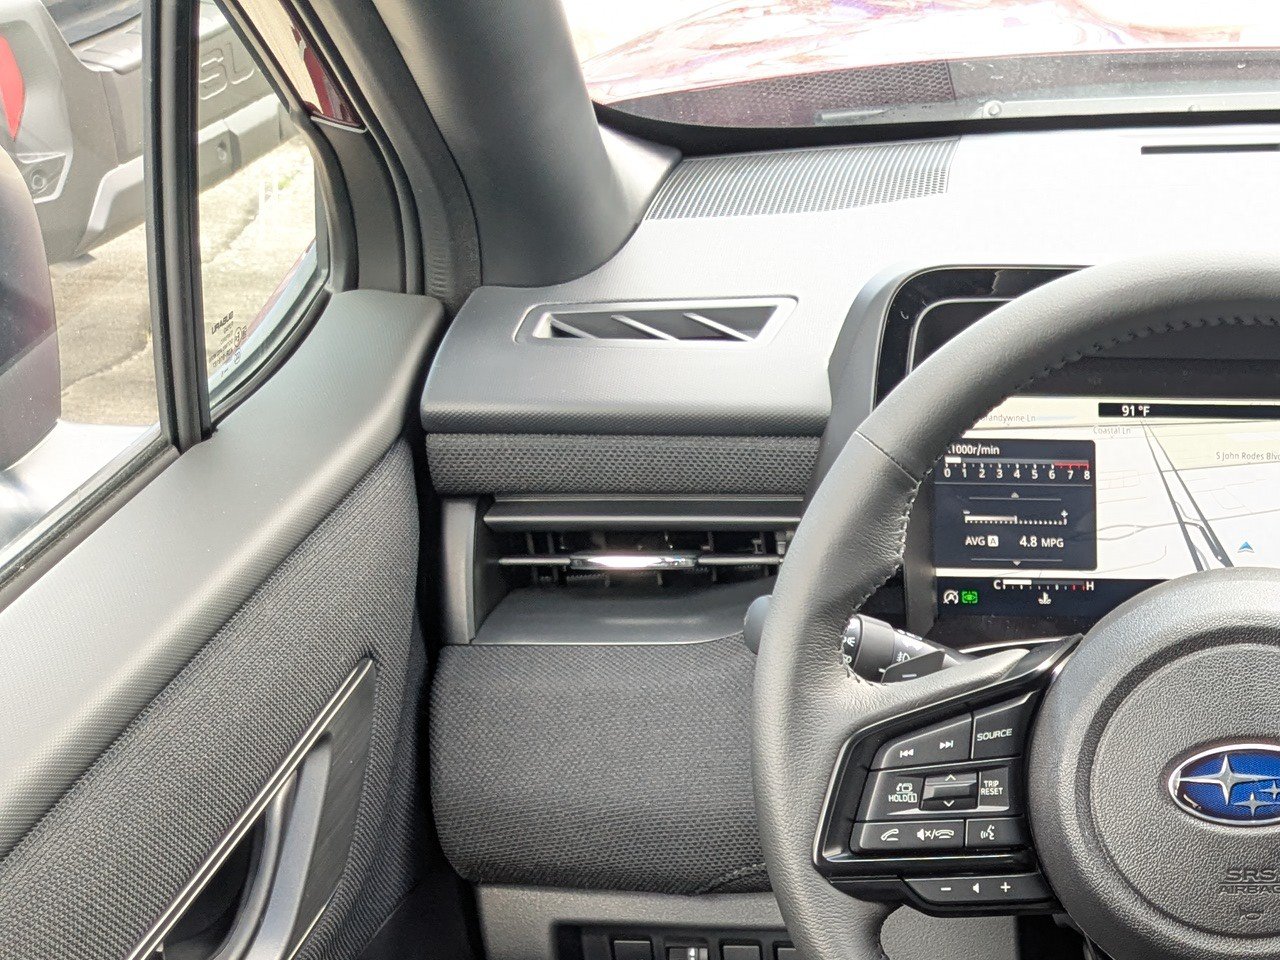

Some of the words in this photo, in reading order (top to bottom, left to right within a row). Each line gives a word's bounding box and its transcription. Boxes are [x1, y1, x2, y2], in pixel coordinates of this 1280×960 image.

[1121, 405, 1135, 417] 91
[1093, 426, 1120, 435] Coastal
[1121, 427, 1131, 435] Ln
[948, 443, 1000, 455] 1000r/min
[1216, 452, 1221, 460] S
[1221, 452, 1240, 461] John
[1242, 452, 1264, 460] Rodes
[944, 468, 951, 478] 0
[961, 468, 967, 478] 1
[978, 469, 986, 479] 2
[996, 469, 1003, 479] 3
[1013, 469, 1021, 479] 4
[1031, 469, 1039, 480] 5
[1049, 470, 1056, 480] 6
[1067, 470, 1074, 480] 7
[1083, 470, 1091, 480] 8
[965, 537, 985, 546] AVG
[1019, 536, 1038, 547] 4.8
[1041, 537, 1064, 547] MPG
[993, 580, 1001, 590] C
[1086, 581, 1094, 590] H
[976, 728, 1013, 741] SOURCE
[983, 780, 999, 789] TRIP
[980, 786, 1003, 796] RESET
[888, 793, 907, 803] HOLD
[1225, 868, 1277, 883] SRS
